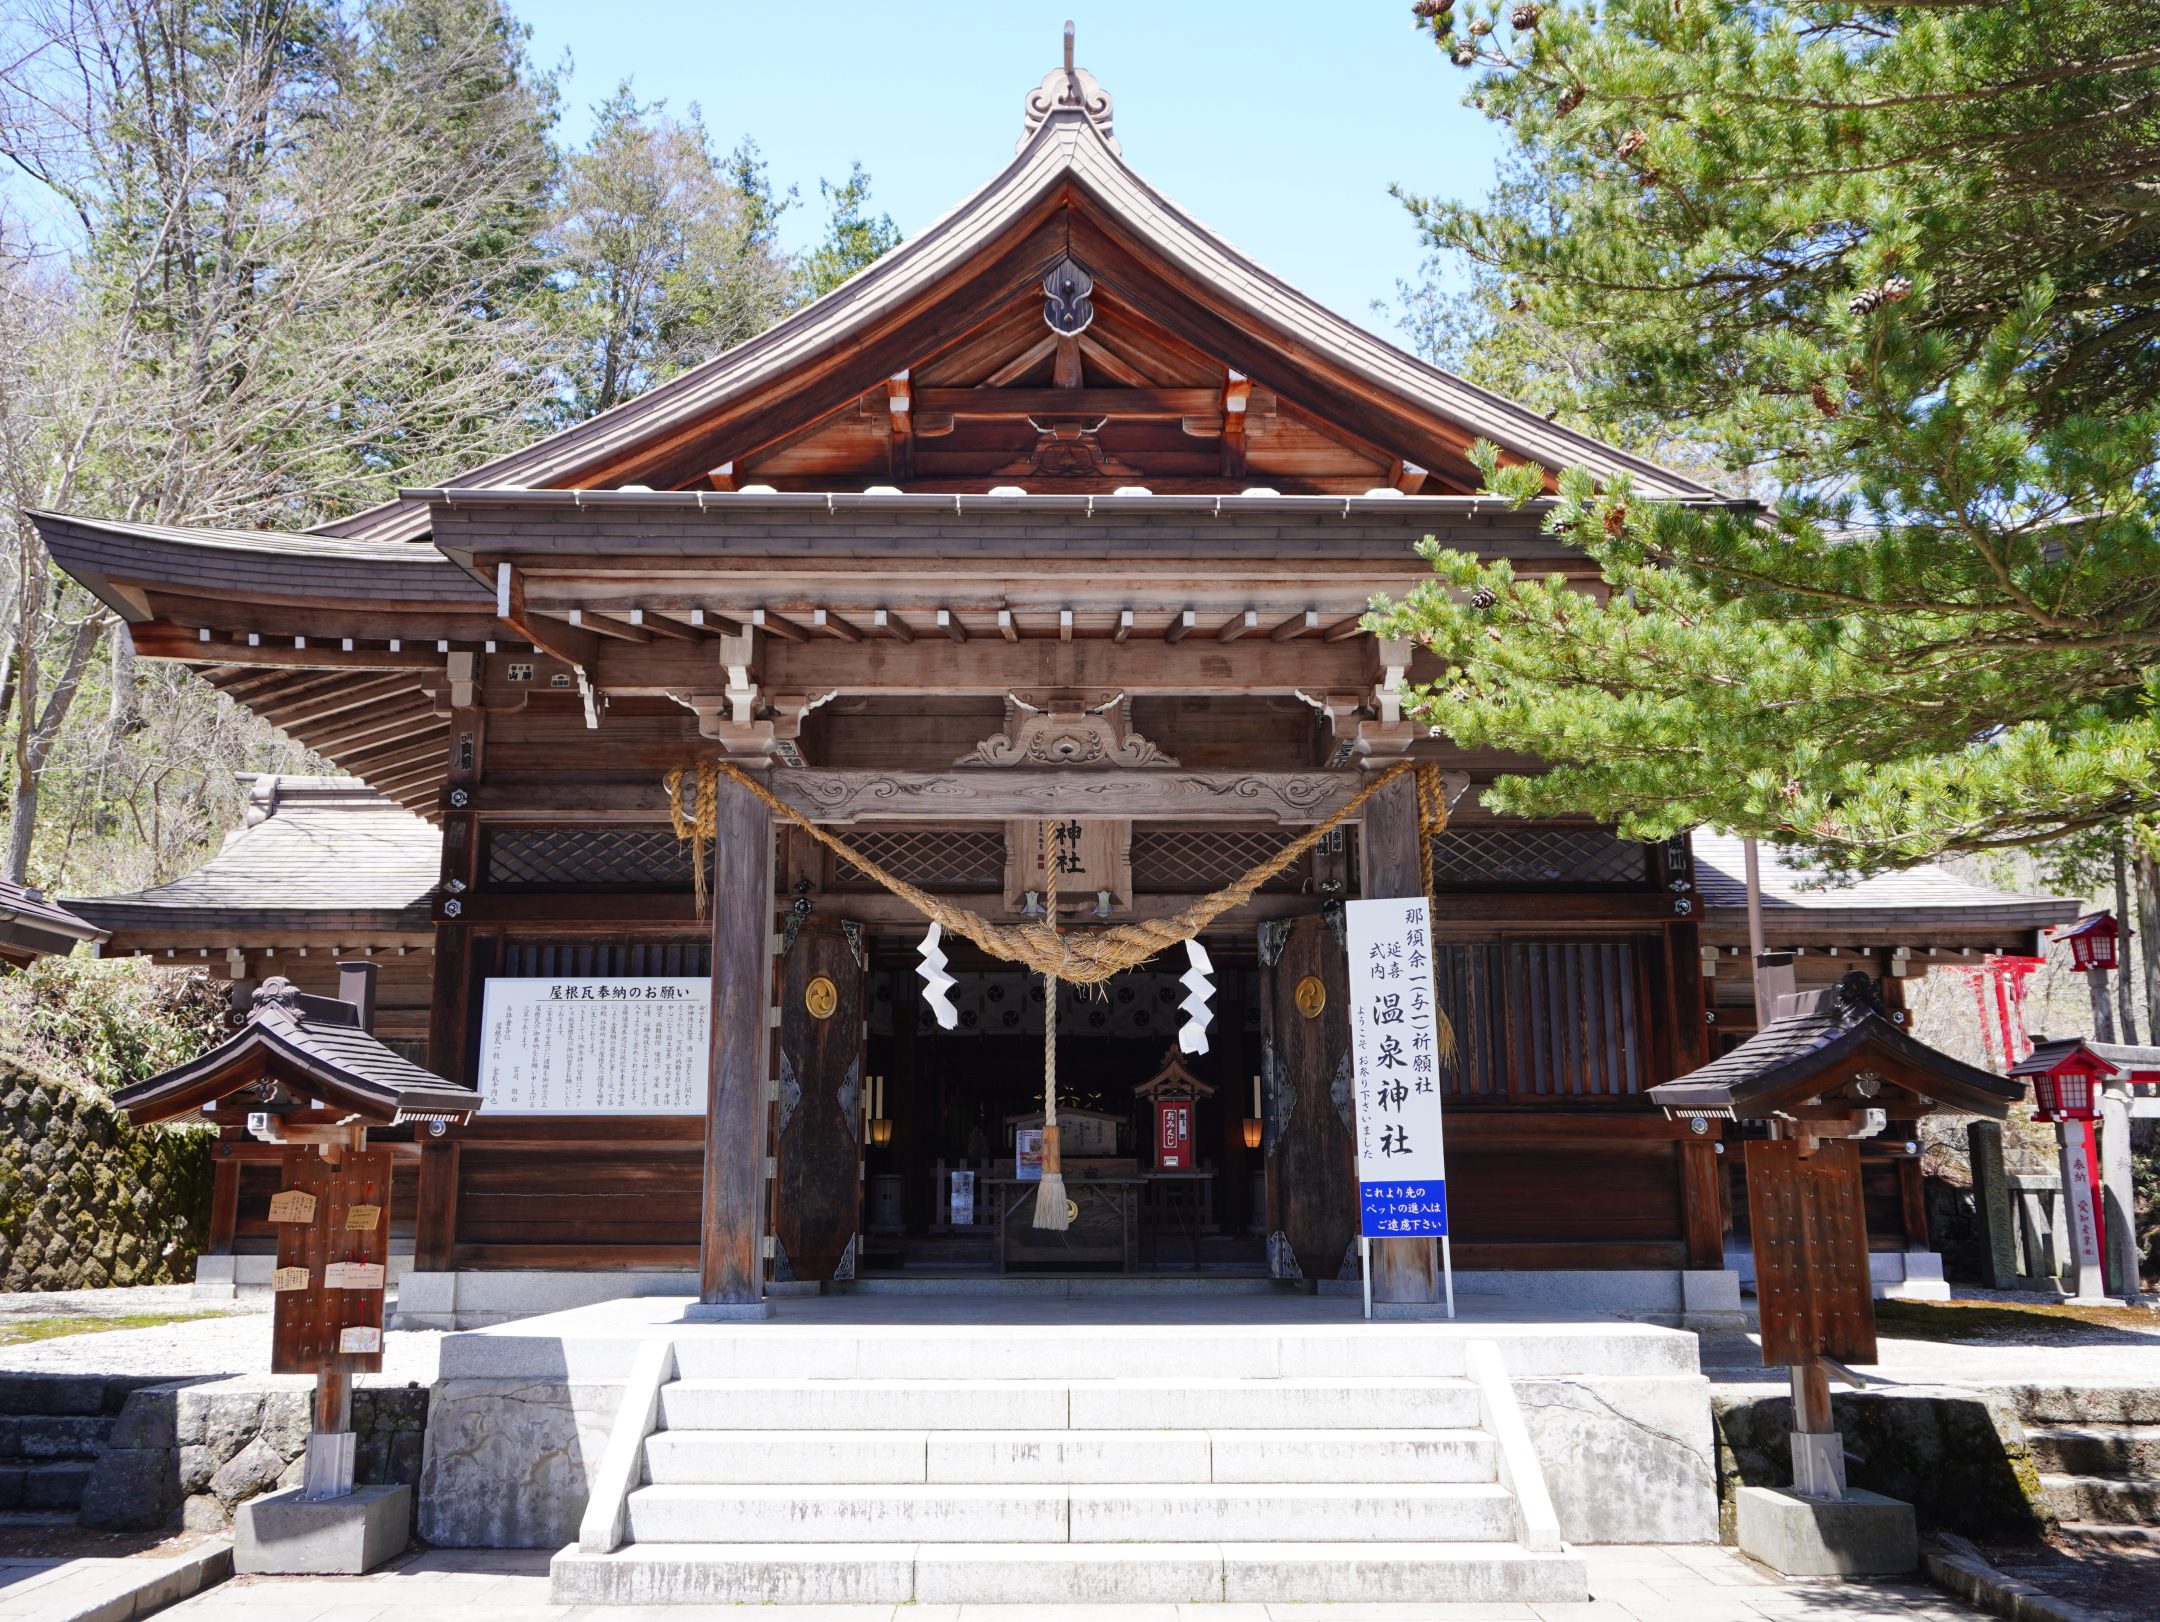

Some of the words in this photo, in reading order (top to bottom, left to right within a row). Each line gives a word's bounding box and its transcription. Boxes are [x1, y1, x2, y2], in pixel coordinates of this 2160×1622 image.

[1056, 820, 1085, 873] 神社
[1370, 943, 1385, 979] 式内
[1387, 941, 1403, 979] 延喜
[550, 984, 690, 999] 屋根瓦奉納のお願い
[493, 1021, 501, 1059] 屋根瓦一枚
[1373, 993, 1413, 1158] 温泉神社
[1166, 1112, 1175, 1146] おみくじ
[2074, 1158, 2086, 1182] 奉納
[1365, 1187, 1426, 1198] これより先の
[1366, 1203, 1441, 1214] ペットの進入は
[1377, 1219, 1442, 1232] ご遠慮下さい
